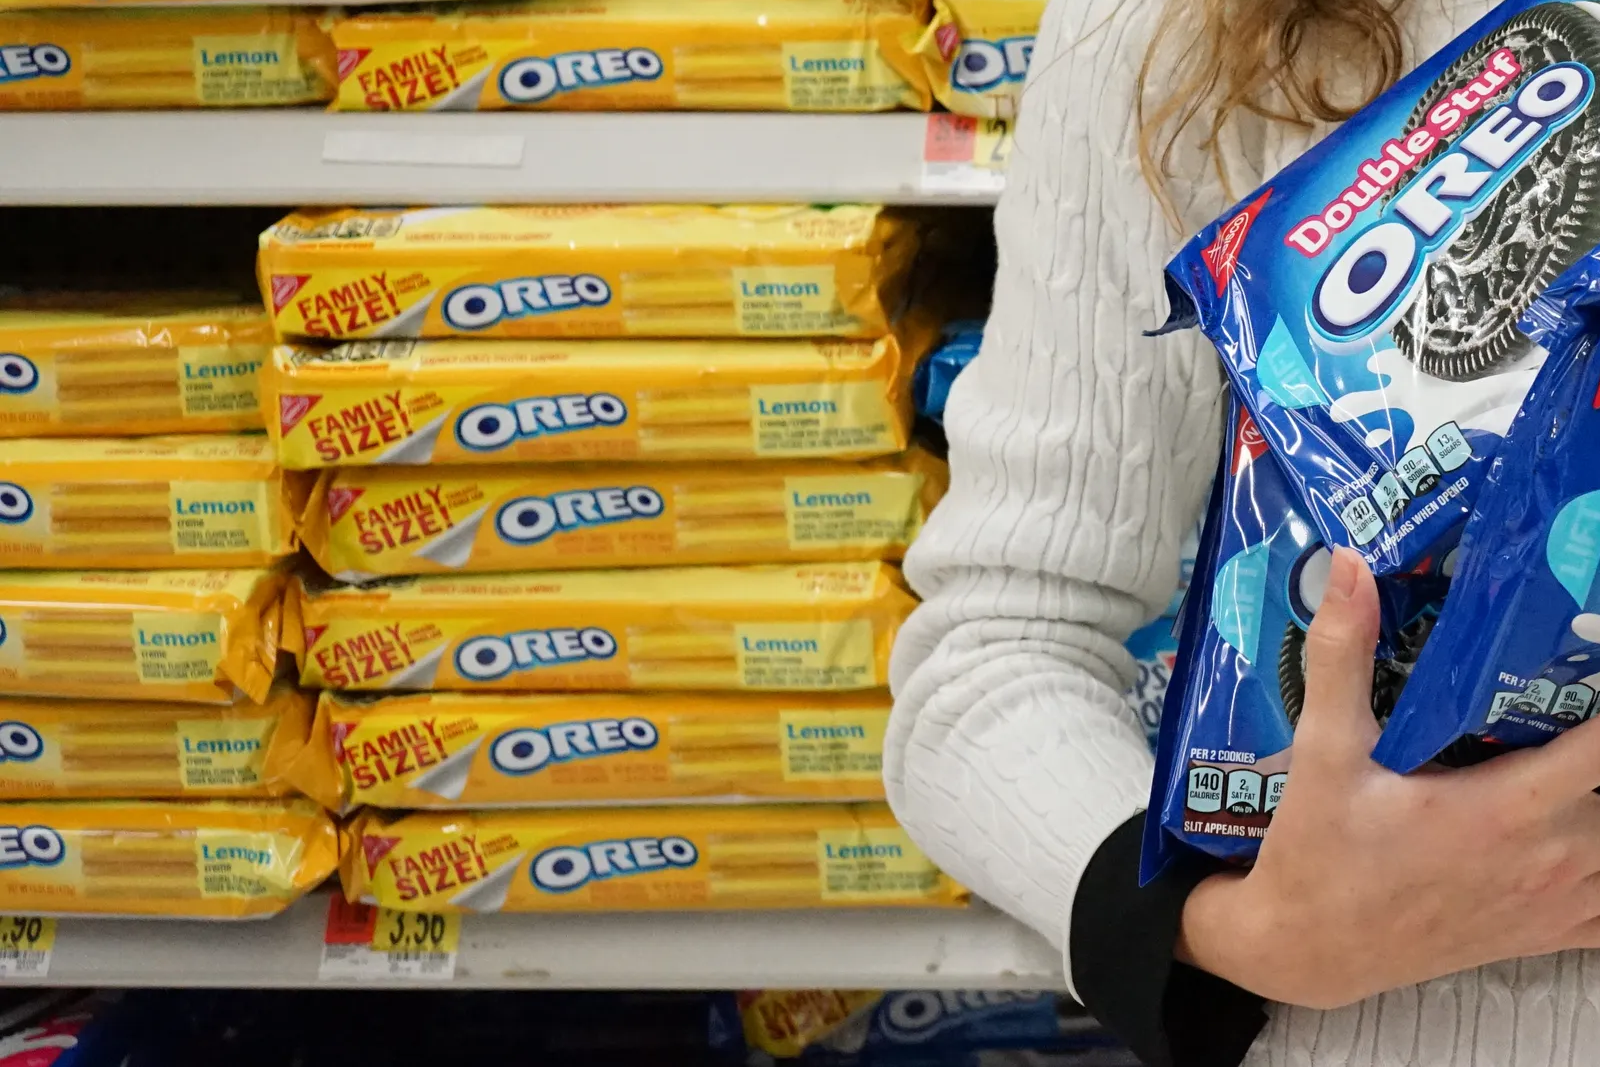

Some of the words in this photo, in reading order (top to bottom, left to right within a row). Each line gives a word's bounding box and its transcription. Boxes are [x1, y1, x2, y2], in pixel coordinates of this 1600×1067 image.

[201, 49, 278, 65] Lemon
[358, 45, 449, 92] FAMILY
[500, 49, 662, 101] OREO
[791, 56, 865, 71] Lemon
[365, 68, 458, 109] SIZE!
[1290, 120, 1434, 254] Double
[1431, 49, 1519, 136] Stuf
[1318, 66, 1585, 331] OREO
[299, 273, 391, 319] FAMILY
[446, 276, 609, 329] OREO
[741, 281, 820, 296] Lemon
[304, 293, 400, 337] SIZE!
[309, 391, 402, 440] FAMILY
[457, 395, 625, 450] OREO
[759, 398, 836, 414] Lemon
[317, 414, 413, 461] SIZE!
[1439, 440, 1462, 459] SUGARS
[1408, 464, 1430, 483] SODIUM
[176, 498, 255, 515] Lemon
[353, 485, 442, 530] FAMILY
[497, 487, 663, 543] OREO
[793, 492, 871, 506] Lemon
[1412, 505, 1439, 526] WHEN
[1437, 476, 1469, 507] OPENED
[357, 511, 453, 555] SIZE!
[139, 628, 216, 646] Lemon
[314, 622, 405, 668] FAMILY
[457, 628, 614, 680] OREO
[743, 636, 819, 652] Lemon
[324, 643, 415, 688] SIZE!
[1498, 671, 1518, 686] PER
[184, 737, 260, 753] Lemon
[346, 717, 439, 765] FAMILY
[493, 719, 657, 772] OREO
[786, 722, 865, 739] Lemon
[354, 738, 446, 789] SIZE!
[1190, 748, 1209, 759] PER
[1210, 750, 1216, 760] 2
[1217, 750, 1256, 764] COOKIES
[1190, 791, 1220, 800] CALORIES
[1194, 772, 1219, 791] 140
[826, 842, 902, 859] Lemon
[1184, 821, 1203, 832] SLIT
[1204, 823, 1245, 836] APPEARS
[203, 845, 271, 865] Lemon
[391, 835, 481, 875] FAMILY
[534, 838, 697, 890] OREO
[396, 855, 487, 900] SIZE!
